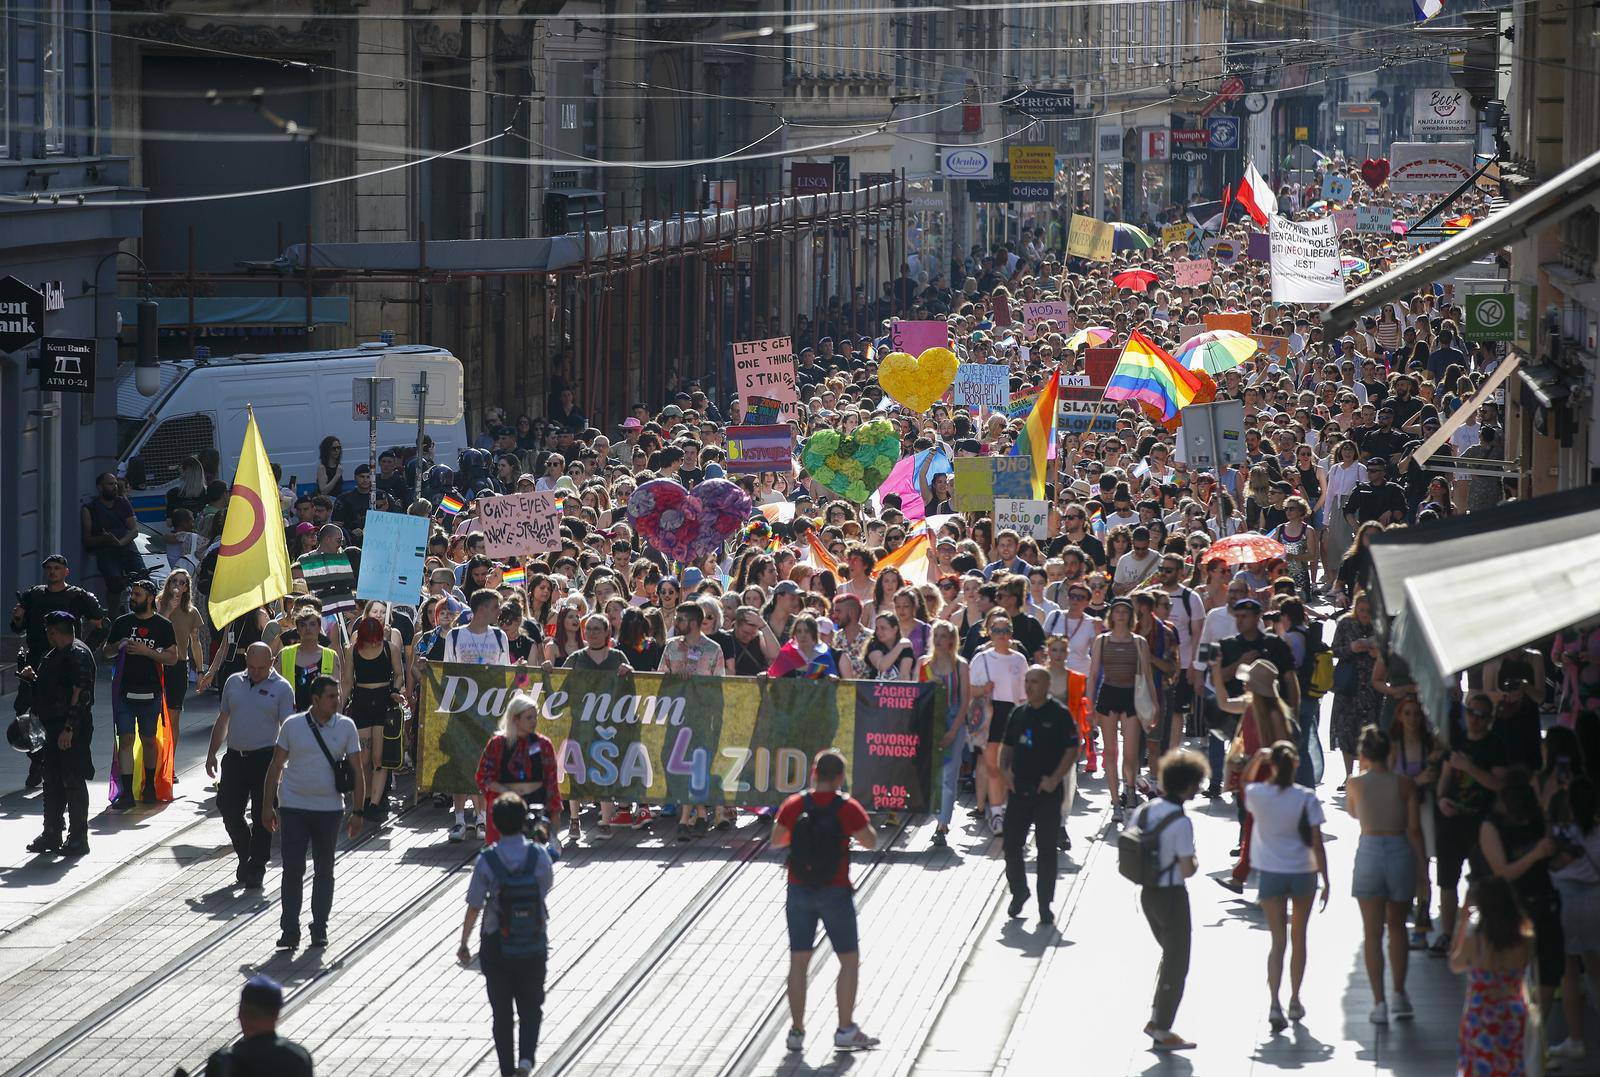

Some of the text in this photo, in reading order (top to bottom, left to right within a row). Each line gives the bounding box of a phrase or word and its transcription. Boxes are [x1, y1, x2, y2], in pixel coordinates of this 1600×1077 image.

[1173, 131, 1200, 141] Triumph
[951, 156, 983, 168] Oculus
[798, 176, 828, 187] LISCA
[1311, 224, 1329, 236] NIJE
[0, 301, 28, 314] ent
[0, 316, 35, 333] ank
[47, 343, 90, 353] Kent Bank
[734, 337, 791, 356] LET'S GET
[737, 353, 793, 370] ONE THING
[47, 377, 88, 387] ATM 0-24
[1068, 378, 1083, 386] AM
[520, 494, 550, 514] EVEN
[1011, 501, 1026, 513] BE
[998, 513, 1047, 526] PROUD OF
[131, 627, 138, 637] I
[434, 675, 686, 727] Date nam
[879, 697, 914, 709] PRIDE
[866, 732, 920, 746] POVORKA
[868, 745, 917, 758] PONOSA
[556, 726, 818, 794] AŠA 4 ZID
